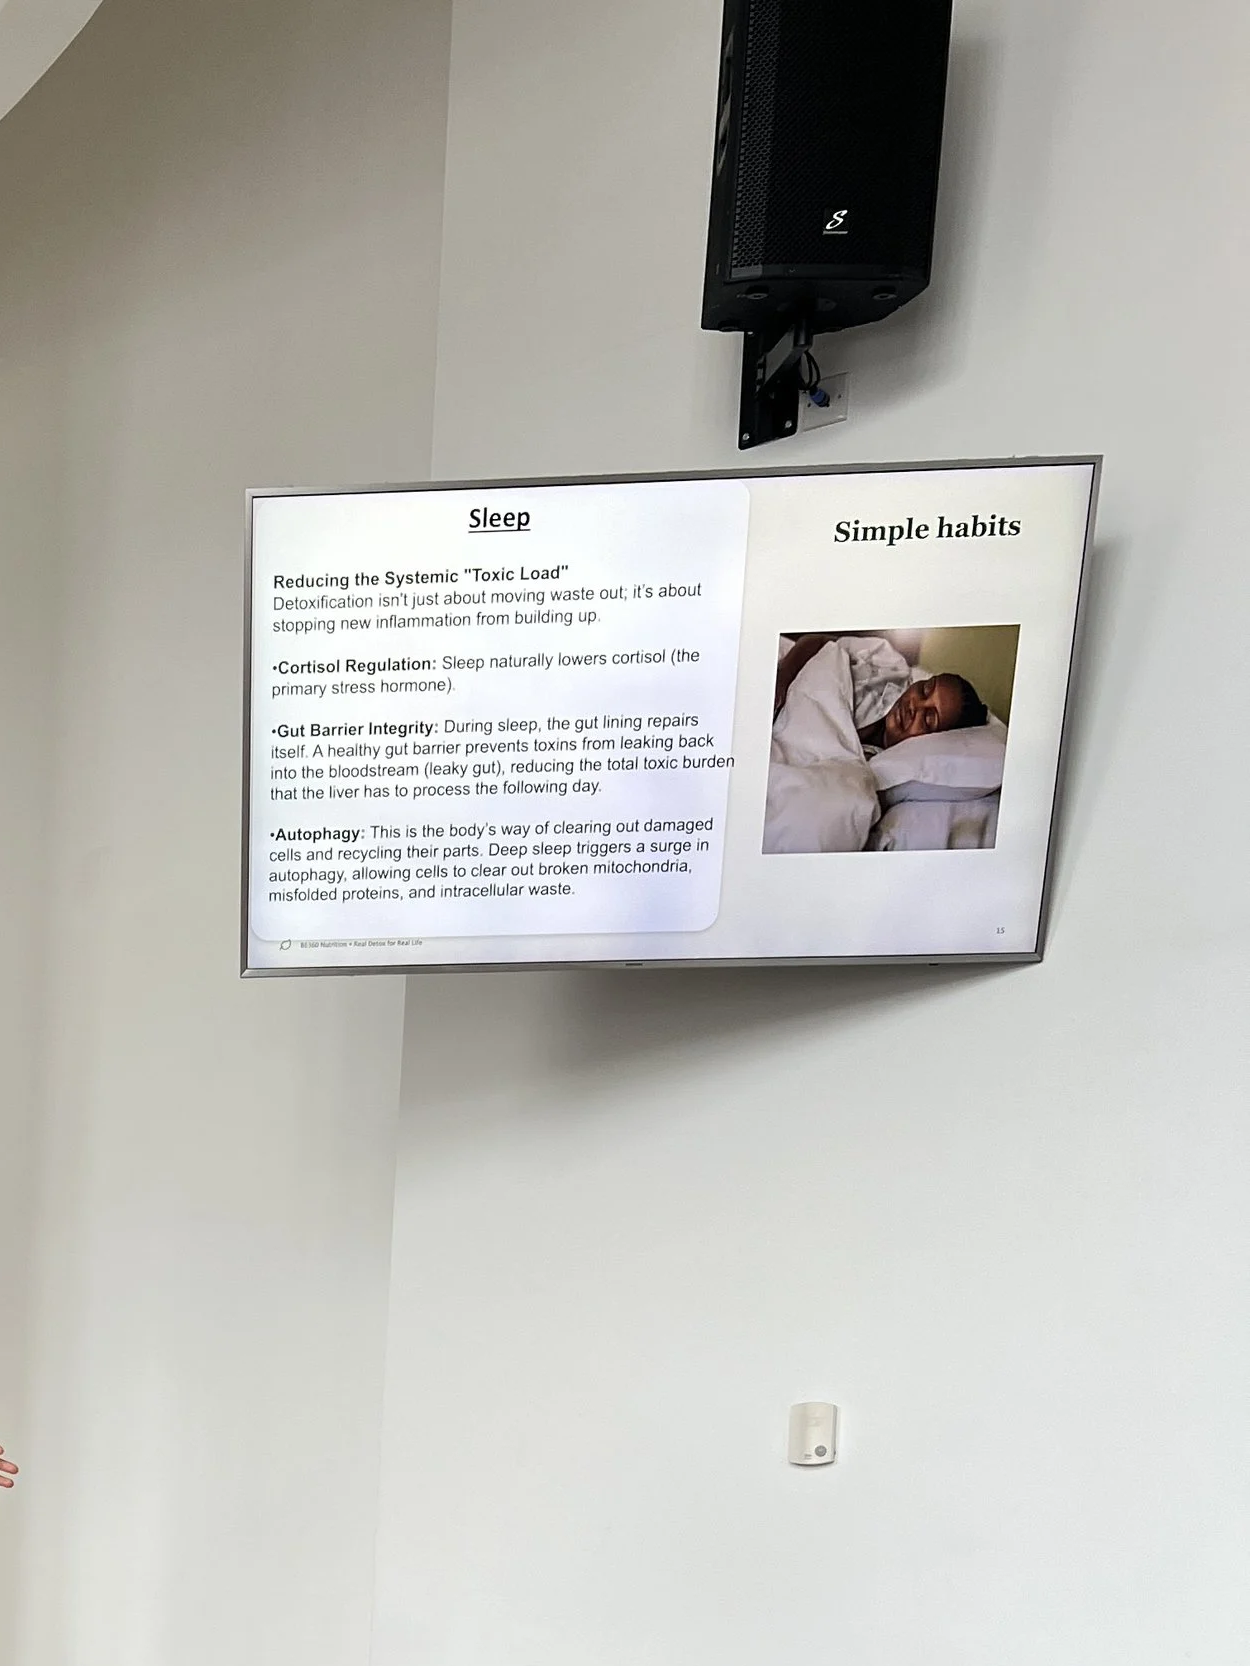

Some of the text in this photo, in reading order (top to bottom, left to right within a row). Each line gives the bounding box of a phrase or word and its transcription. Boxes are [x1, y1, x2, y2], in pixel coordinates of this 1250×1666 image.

[468, 506, 531, 534] Sleep
[833, 514, 1021, 546] Simple habits
[273, 564, 569, 591] Reducing the Systemic "Toxic Load"
[273, 582, 702, 611] Detoxification isn't just about moving waste out; it's about
[272, 609, 600, 635] stopping new inflammation from building up.
[345, 657, 436, 676] Regulation:
[442, 655, 485, 672] Sleep
[490, 652, 554, 670] naturally
[558, 652, 607, 667] lowers
[612, 648, 666, 665] cortisol
[671, 648, 700, 666] (the
[272, 677, 455, 699] primary stress hormone).
[310, 722, 365, 737] Barrier
[369, 720, 438, 738] Integrity:
[444, 719, 493, 736] During
[497, 718, 541, 735] sleep,
[547, 716, 570, 731] the
[574, 715, 599, 734] gut
[603, 714, 642, 732] lining
[647, 712, 699, 731] repairs
[271, 733, 714, 760] itself. A healthy gut barrier prevents toxins from leaking back
[271, 754, 735, 780] into the bloodstream (leaky gut), reducing the total toxic burden
[270, 778, 602, 801] that the liver has to process the following day.
[370, 825, 401, 839] This
[405, 825, 417, 838] is
[422, 824, 445, 838] the
[449, 822, 496, 840] body's
[501, 825, 531, 839] way
[535, 820, 550, 835] of
[553, 820, 611, 837] clearing
[616, 819, 640, 833] out
[643, 817, 714, 835] damaged
[269, 838, 709, 863] cells and recycling their parts. Deep sleep triggers a surge in
[269, 858, 692, 885] autophagy, allowing cells to clear out broken mitochondria,
[269, 882, 575, 904] misfolded proteins, and intracellular waste.
[996, 926, 1005, 934] 15
